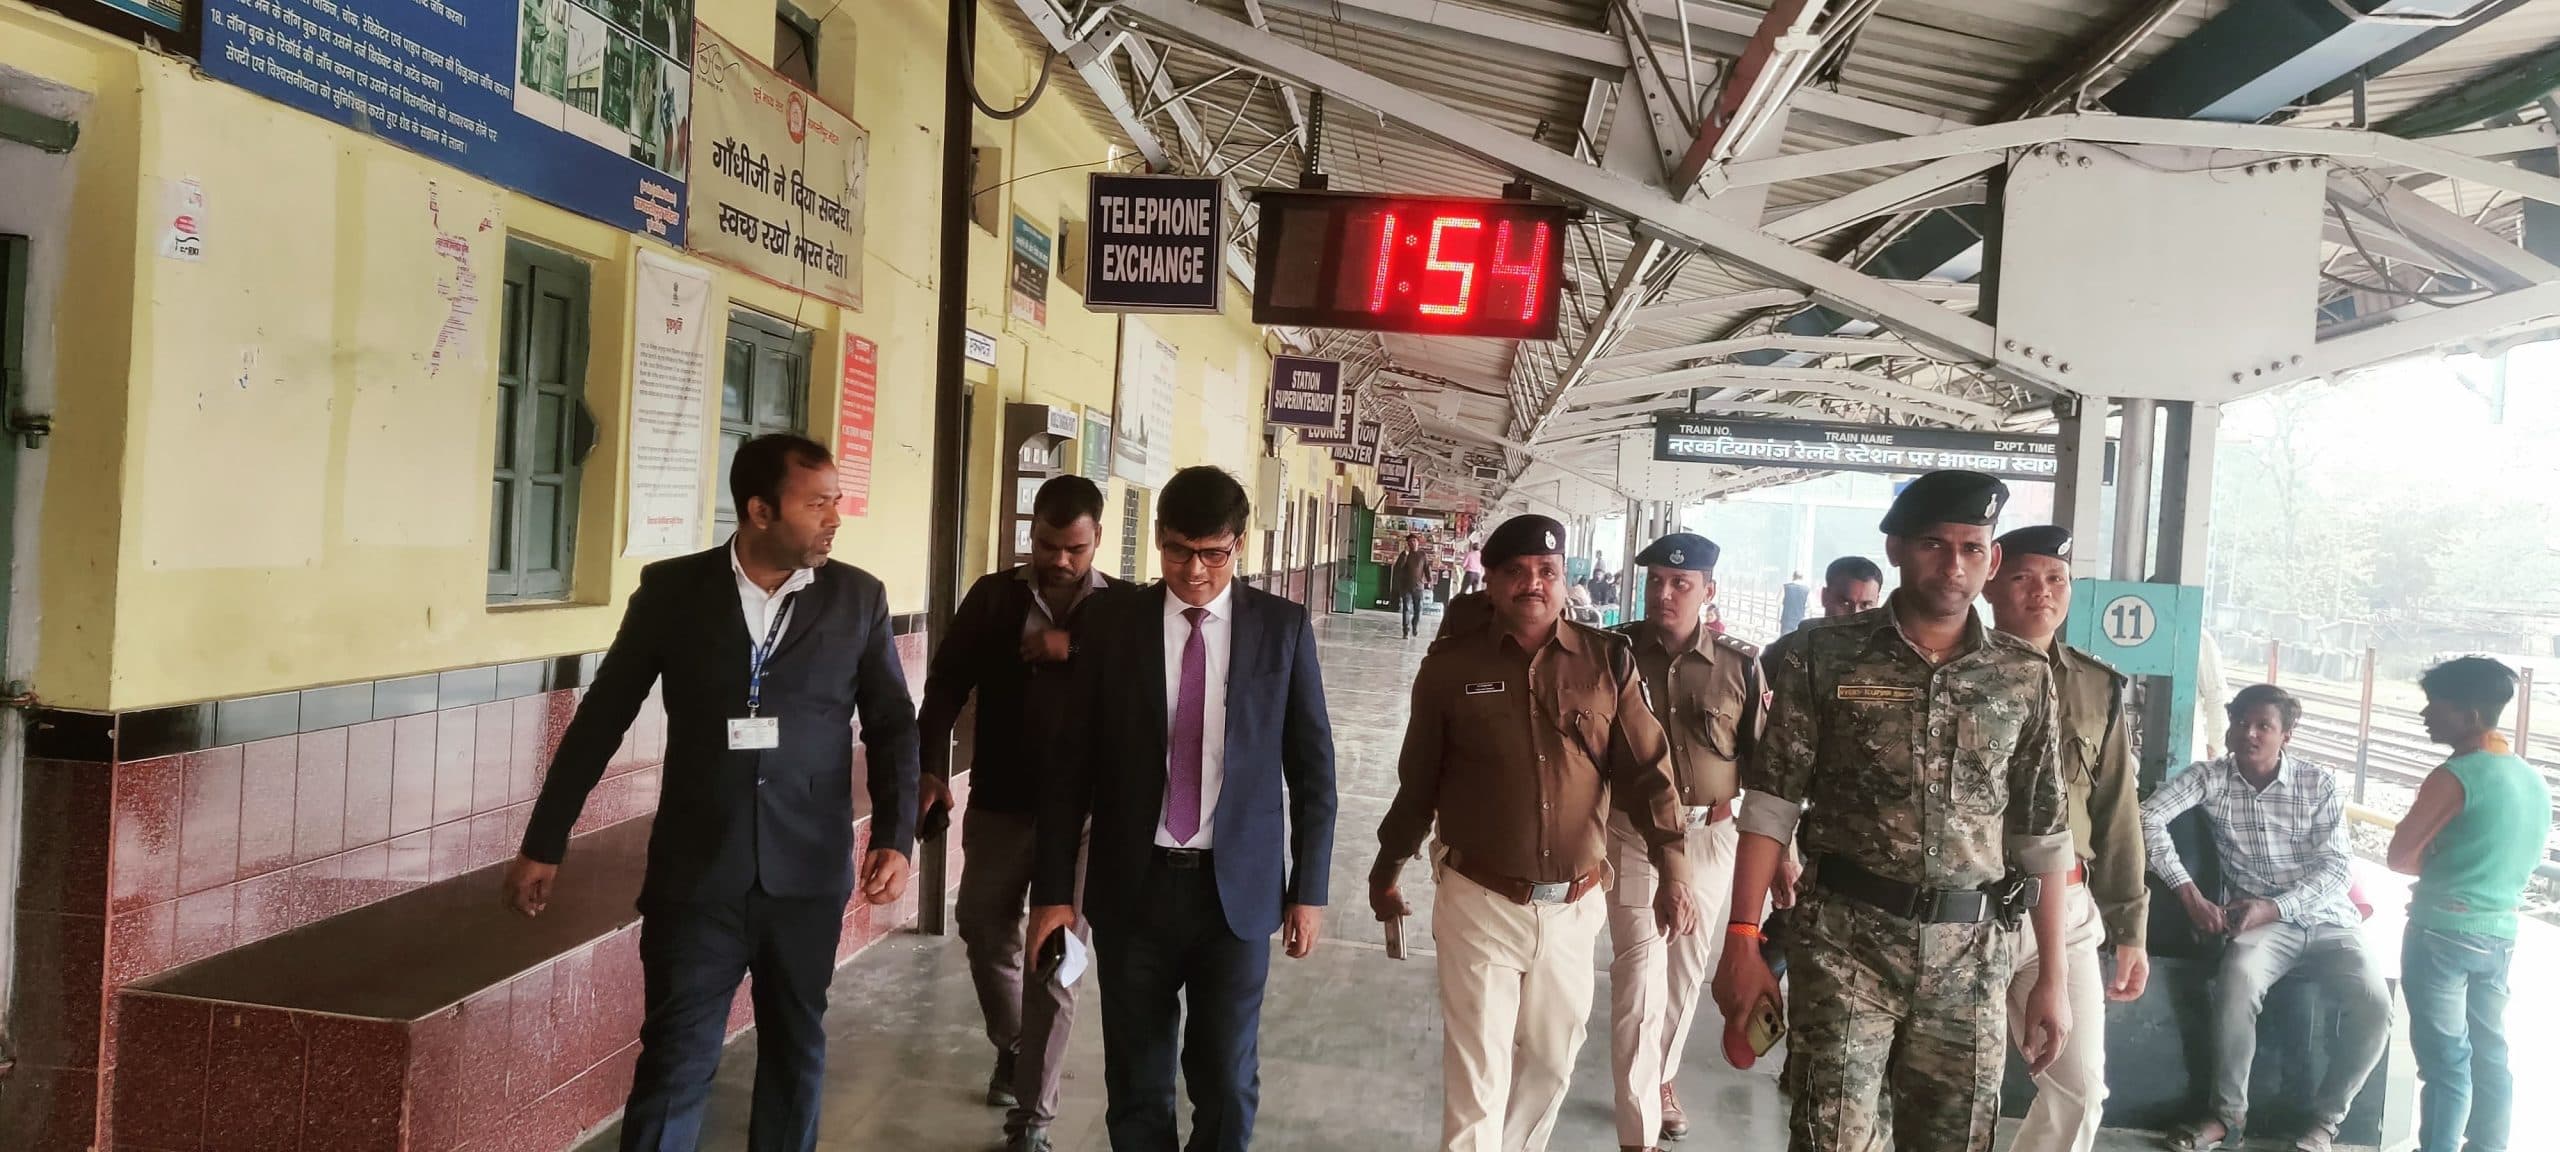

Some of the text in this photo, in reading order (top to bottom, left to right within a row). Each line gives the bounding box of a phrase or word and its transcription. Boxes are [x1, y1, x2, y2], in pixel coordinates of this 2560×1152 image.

[445, 6, 466, 28] करना।
[283, 7, 301, 29] लॉग
[302, 18, 318, 39] बुक
[319, 25, 331, 42] एवं
[392, 57, 403, 75] को
[390, 32, 402, 48] एवं
[210, 8, 224, 26] 18.
[226, 13, 247, 35] लॉग
[249, 24, 265, 45] बुक
[265, 27, 276, 47] के
[302, 45, 314, 65] की
[315, 52, 333, 72] जाँच
[334, 62, 355, 82] करना
[356, 70, 368, 87] एवं
[389, 84, 402, 101] दर्ज
[437, 102, 447, 121] को
[488, 129, 498, 143] पर
[251, 54, 265, 73] एवं
[267, 58, 318, 95] विश्वसनीयता
[319, 80, 331, 100] को
[368, 100, 386, 121] करते
[386, 111, 398, 129] हुए
[411, 117, 420, 134] के
[712, 135, 770, 194] गाँधीजी
[774, 164, 787, 202] ने
[791, 170, 817, 217] दिया
[1100, 195, 1211, 236] TELEPHONE
[718, 201, 848, 279] स्वच्छ रखो भारत देश।
[1102, 244, 1204, 284] EXCHANGE
[1370, 213, 1549, 320] 1:54
[1292, 370, 1321, 390] STATION
[1274, 390, 1335, 414] SUPERINTENDENT
[1341, 395, 1353, 415] ED
[1358, 425, 1376, 443] ION
[1680, 424, 1733, 436] TRAIN NO.
[1824, 431, 1894, 446] TRAIN NAME
[1333, 446, 1373, 464] MASTER
[1668, 436, 2057, 474] नरकटियागंज रेलवे स्टेशन पर आपका स्वाग
[1994, 440, 2056, 454] EXPT. TIME
[2111, 605, 2143, 639] 11
